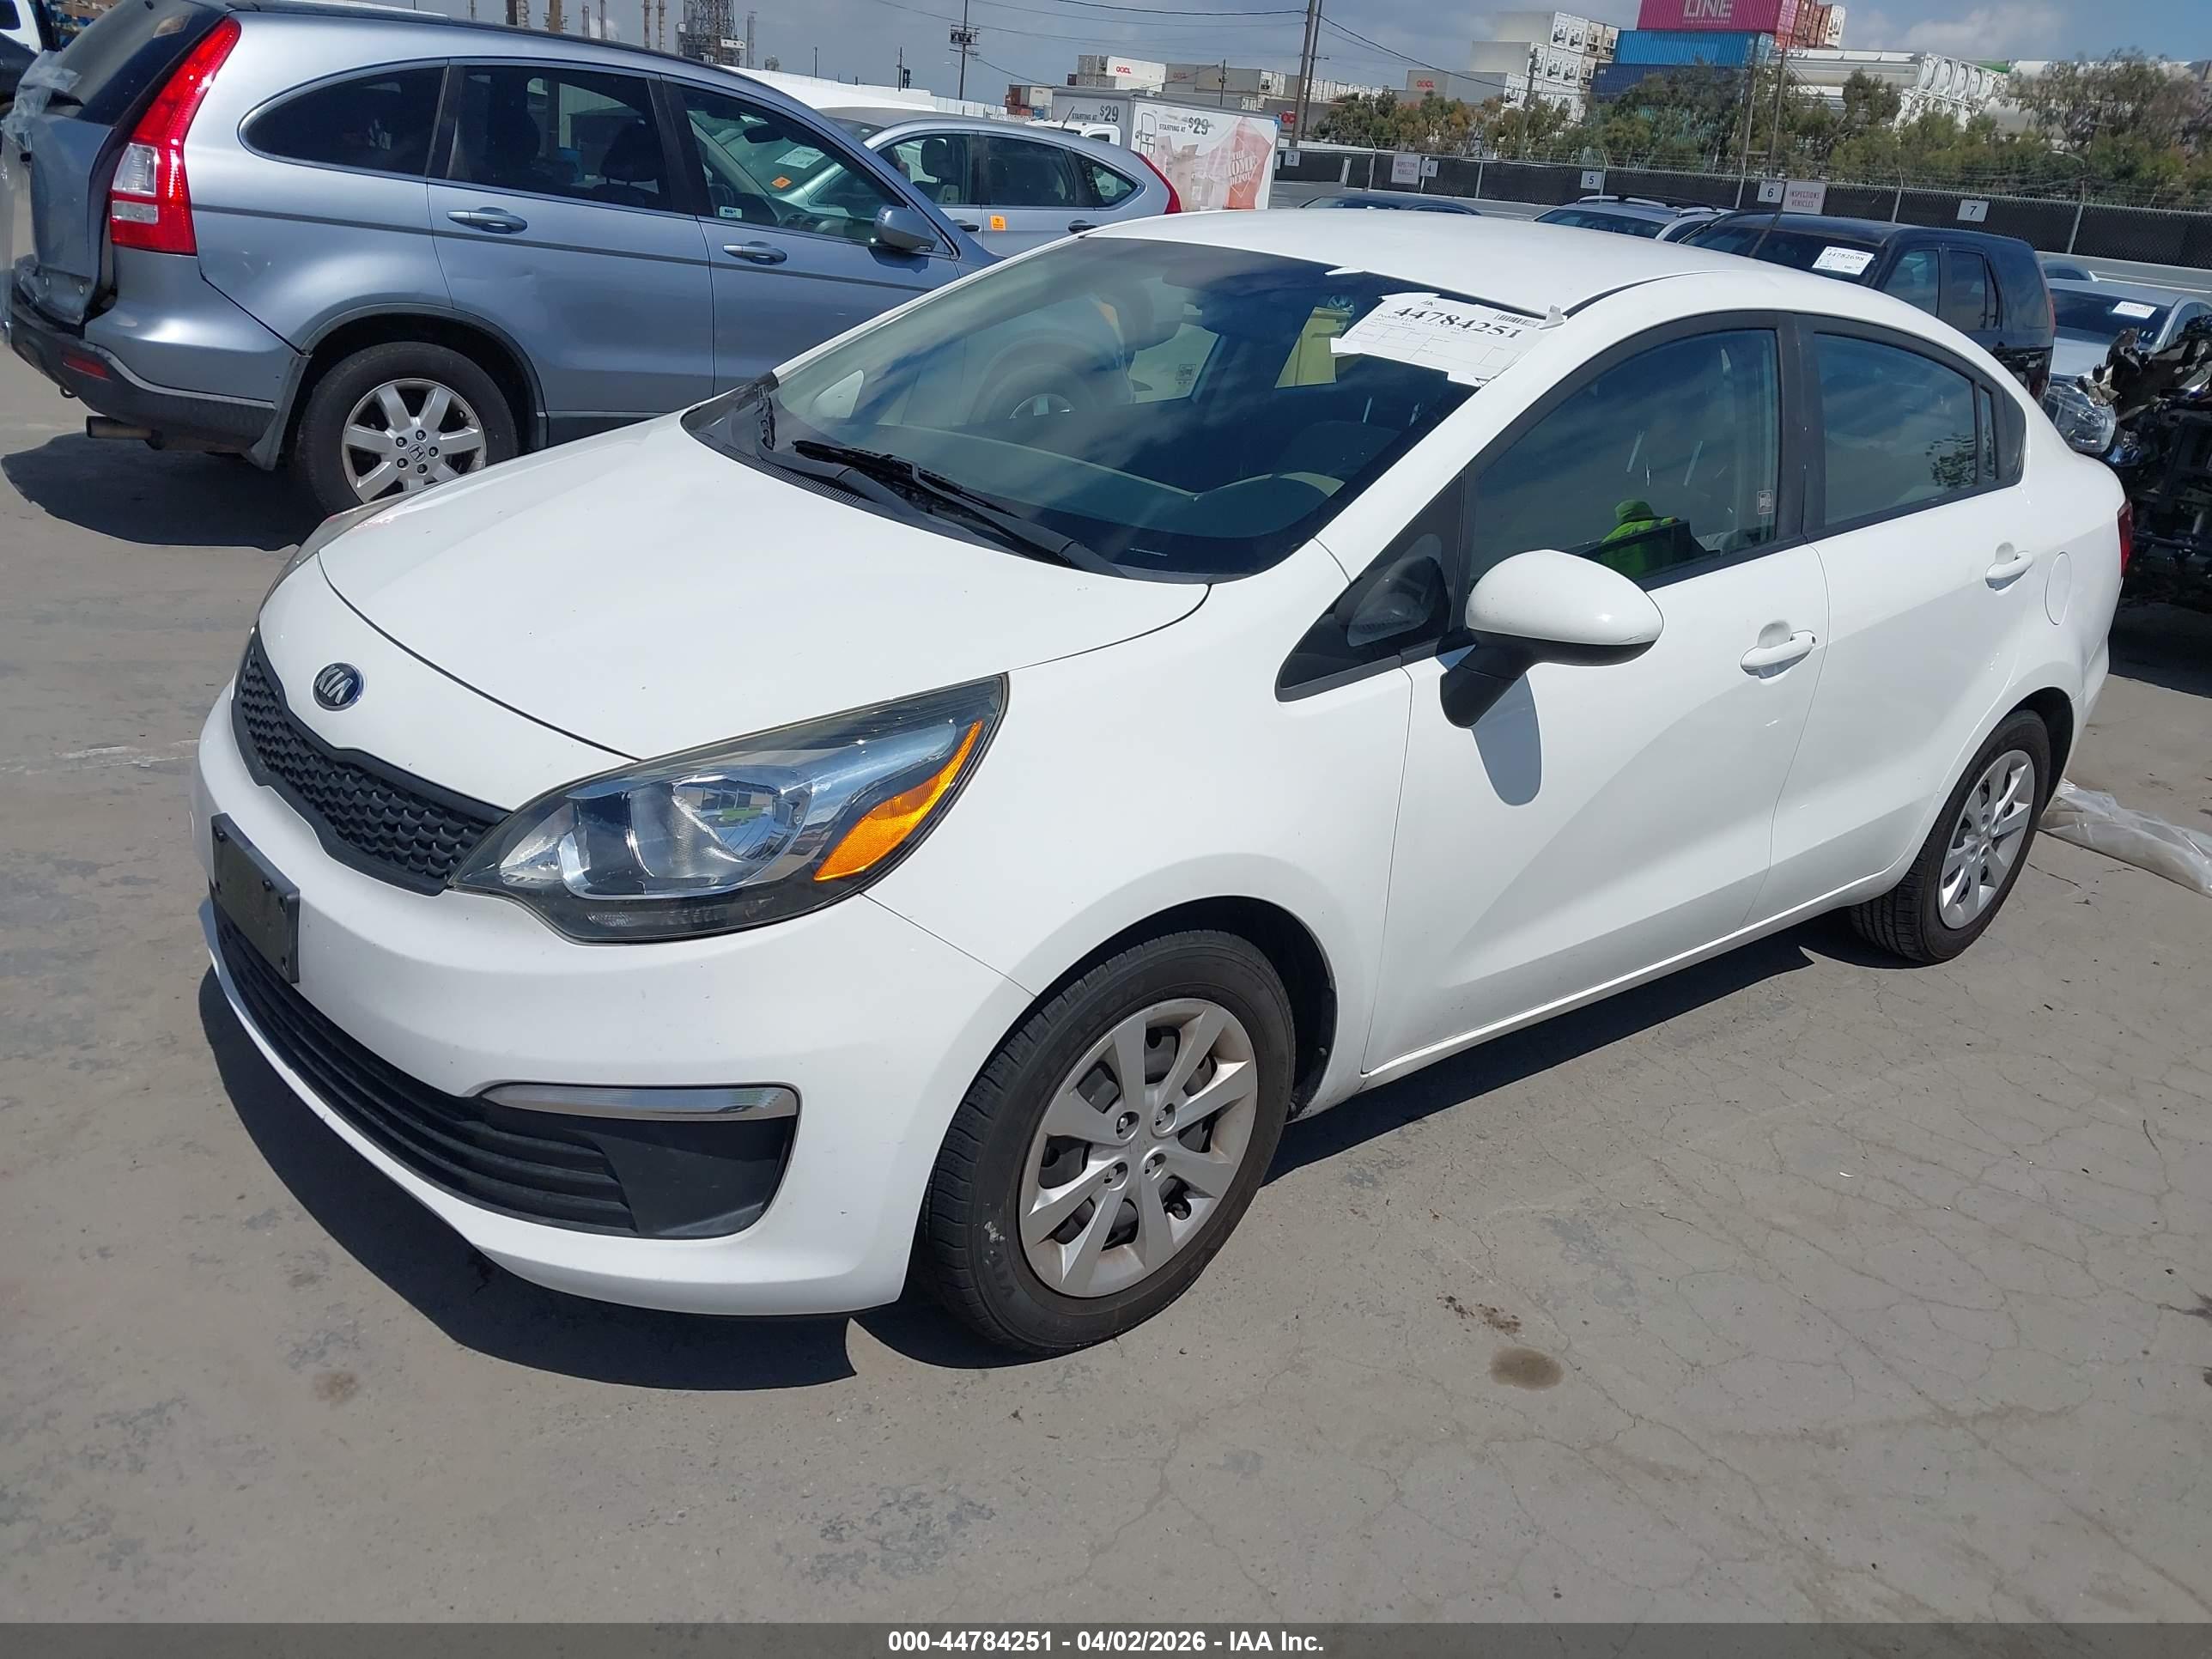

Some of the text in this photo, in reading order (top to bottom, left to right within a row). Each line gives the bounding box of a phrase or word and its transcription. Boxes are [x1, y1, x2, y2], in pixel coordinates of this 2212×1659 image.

[1116, 66, 1132, 75] OOCL
[1100, 105, 1119, 122] $29
[1158, 124, 1179, 132] STARTING
[1188, 117, 1209, 135] $29
[1427, 164, 1431, 173] 4
[1589, 175, 1595, 185] 5
[1767, 188, 1774, 198] 6
[1970, 205, 1978, 216] 7
[1394, 307, 1522, 338] 44784251
